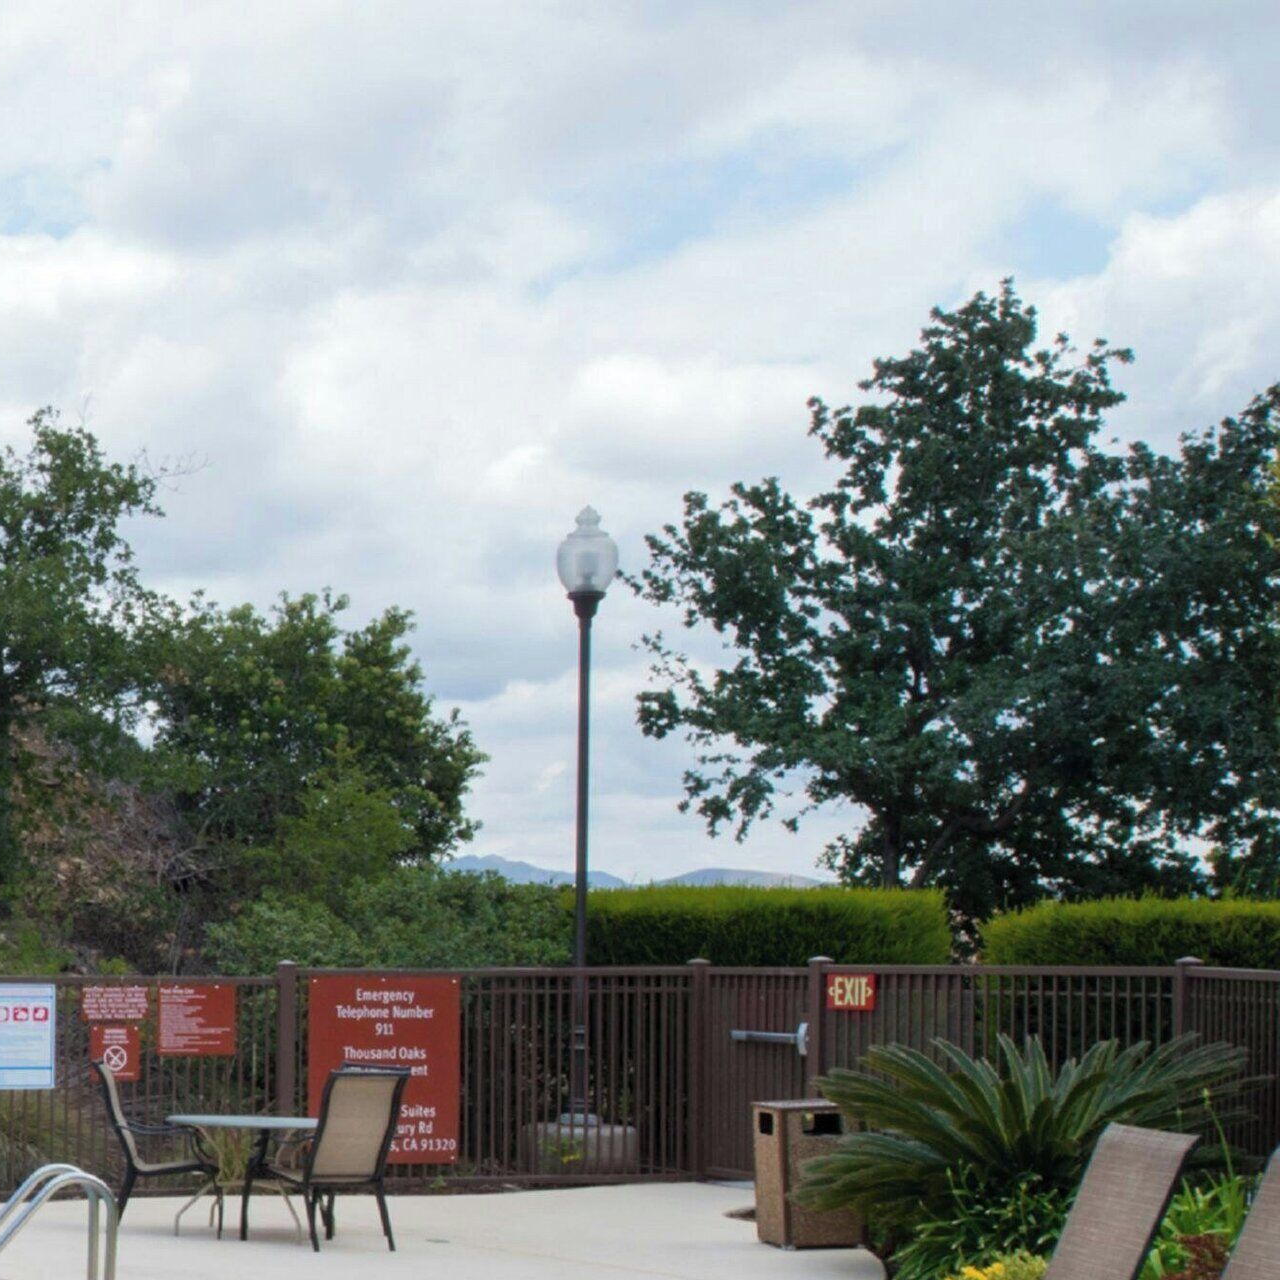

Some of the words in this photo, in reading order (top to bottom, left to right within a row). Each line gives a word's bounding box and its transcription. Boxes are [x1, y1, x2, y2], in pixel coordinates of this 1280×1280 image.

[356, 988, 415, 1004] Emergency
[834, 976, 868, 1006] EXIT
[336, 1005, 390, 1020] Telephone
[392, 1005, 434, 1018] Number
[375, 1022, 394, 1036] 911
[344, 1046, 397, 1060] Thousand
[399, 1047, 427, 1060] Oaks
[401, 1104, 436, 1118] Suites
[418, 1120, 433, 1134] Rd
[403, 1138, 418, 1151] CA
[420, 1138, 457, 1152] 91320
